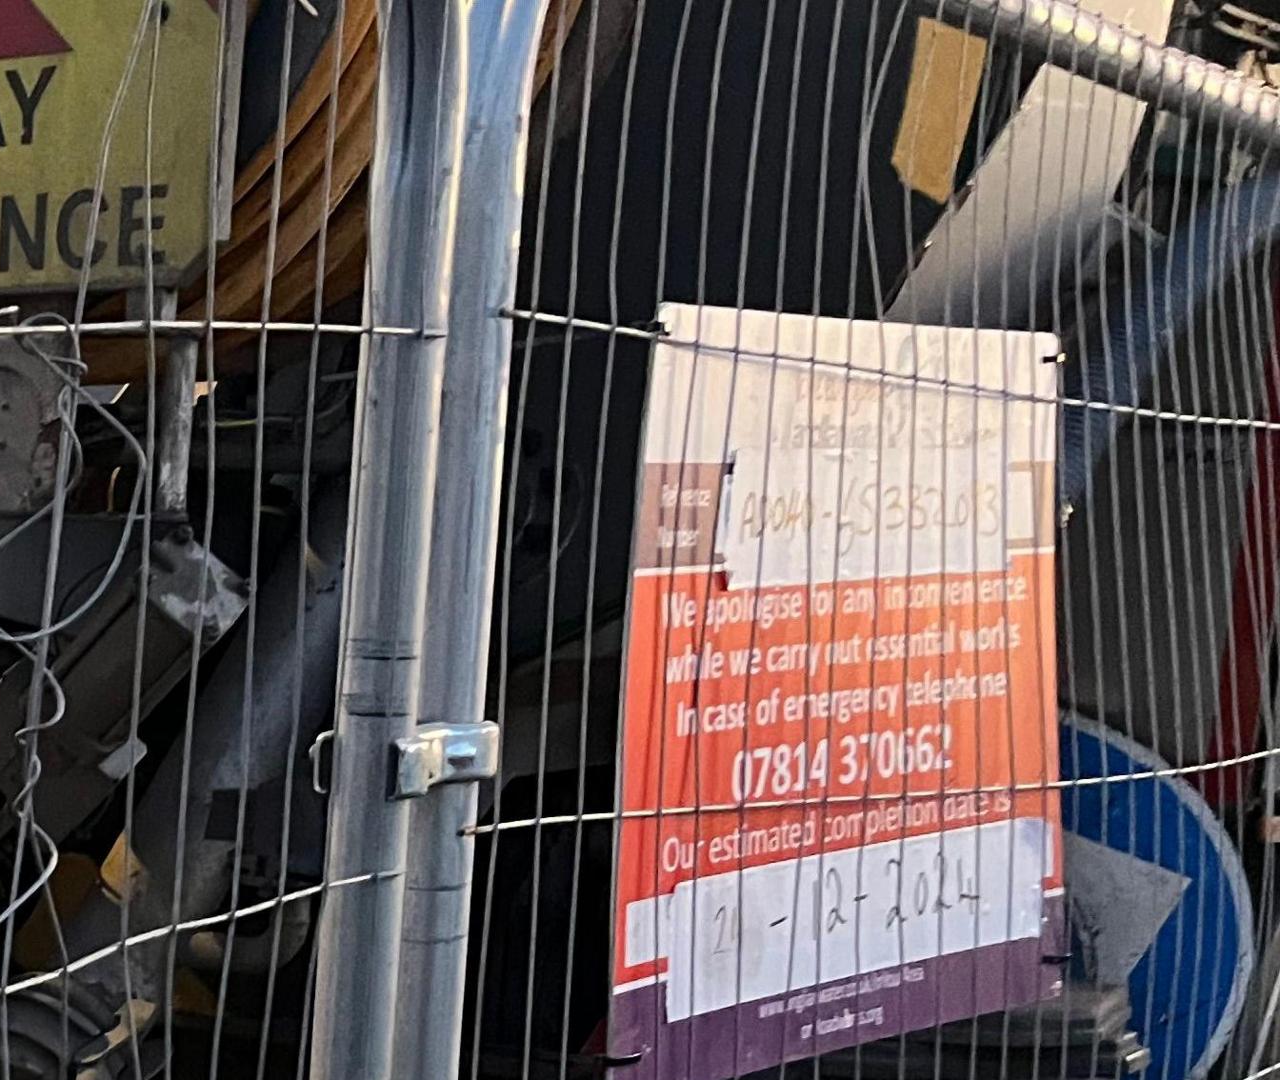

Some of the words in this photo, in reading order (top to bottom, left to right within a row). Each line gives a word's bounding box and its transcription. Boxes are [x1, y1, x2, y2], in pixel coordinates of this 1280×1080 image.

[661, 590, 697, 628] We
[705, 588, 803, 633] apologise
[810, 584, 835, 617] for
[842, 587, 877, 621] any
[884, 576, 1027, 611] inconvenence
[666, 641, 725, 685] while
[728, 645, 762, 677] we
[766, 642, 822, 677] carry
[825, 634, 861, 665] out
[866, 619, 956, 662] essential
[959, 616, 1021, 653] works
[677, 701, 697, 737] In
[703, 702, 746, 733] case
[756, 687, 781, 726] of
[783, 683, 900, 723] emergency
[906, 668, 1008, 709] telephone
[731, 738, 829, 801] 07814
[839, 724, 954, 785] 370662
[662, 836, 705, 873] Our
[708, 811, 816, 864] estimated
[823, 799, 939, 844] completion
[943, 790, 990, 821] date
[993, 787, 1012, 813] is
